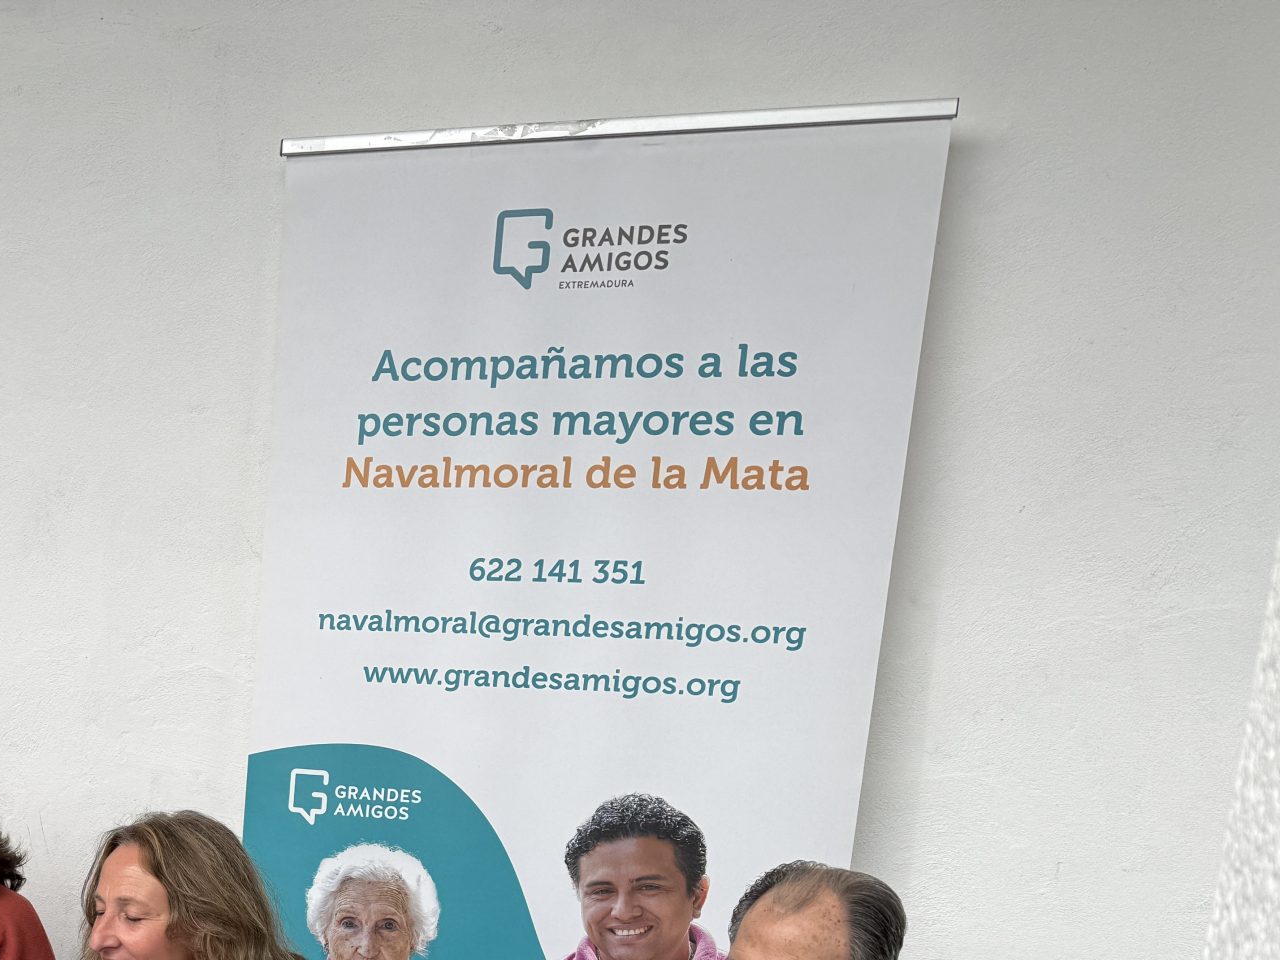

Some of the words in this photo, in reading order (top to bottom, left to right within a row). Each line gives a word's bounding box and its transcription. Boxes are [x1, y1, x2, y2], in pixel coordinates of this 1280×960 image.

[563, 224, 688, 248] GRANDES
[560, 250, 669, 273] AMIGOS
[558, 279, 634, 289] EXTREMADURA
[371, 346, 684, 388] Acompañamos
[697, 352, 722, 377] a
[737, 343, 798, 378] las
[357, 409, 539, 445] personas
[552, 409, 735, 445] mayores
[748, 409, 804, 437] en
[342, 456, 572, 490] Navalmoral
[585, 456, 636, 490] de
[650, 456, 687, 490] la
[699, 457, 810, 491] Mata
[468, 557, 522, 582] 622
[531, 559, 584, 583] 141
[591, 559, 646, 585] 351
[317, 608, 807, 651] navalmoral@grandesamigos.org
[362, 663, 742, 703] www.grandesamigos.org
[334, 785, 422, 803] GRANDES
[333, 802, 409, 820] AMIGOS
